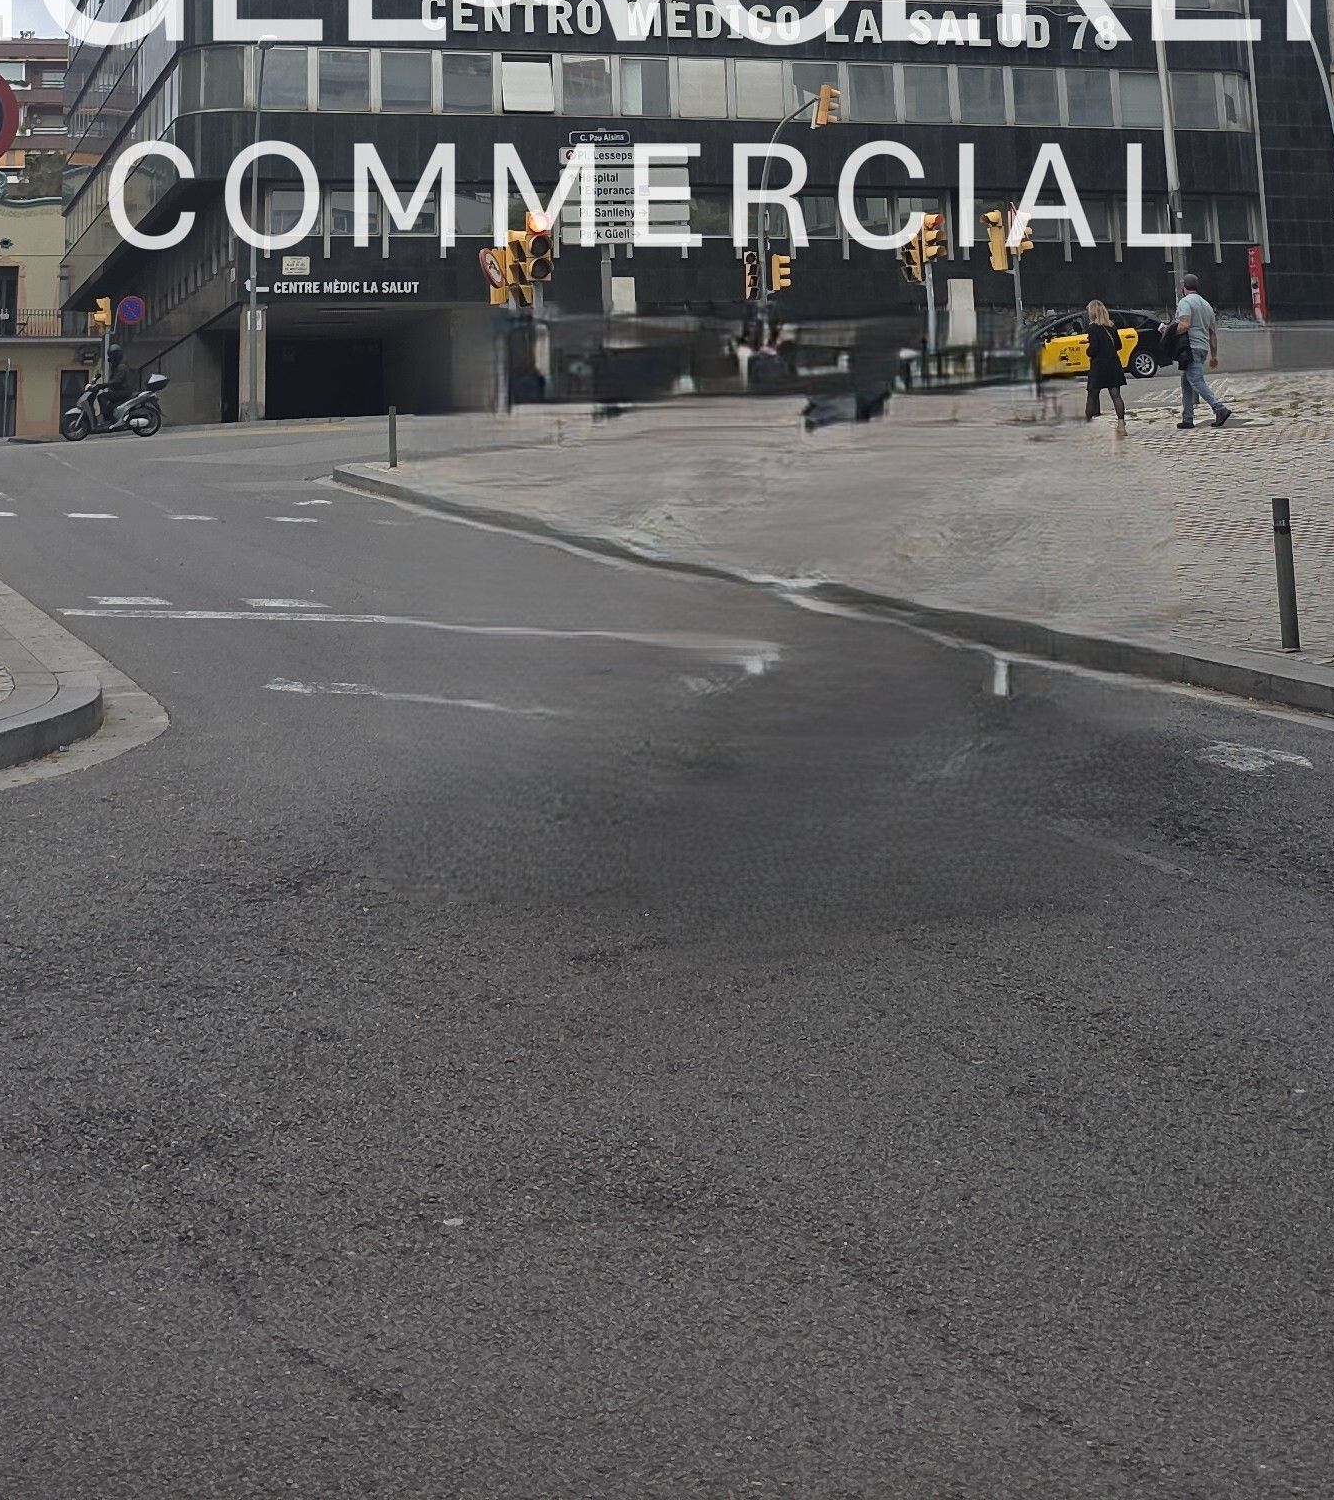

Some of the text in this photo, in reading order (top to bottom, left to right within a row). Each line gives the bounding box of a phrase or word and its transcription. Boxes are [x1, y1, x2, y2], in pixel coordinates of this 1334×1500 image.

[824, 7, 883, 43] LA
[907, 9, 1050, 48] SALUD
[1067, 14, 1118, 51] 78
[592, 150, 633, 162] Lesseps
[579, 172, 619, 184] Hospital
[594, 207, 635, 219] Sanllehy
[579, 228, 630, 239] Park Güell
[273, 279, 420, 294] CENTRE MÈDIC LA SALUT
